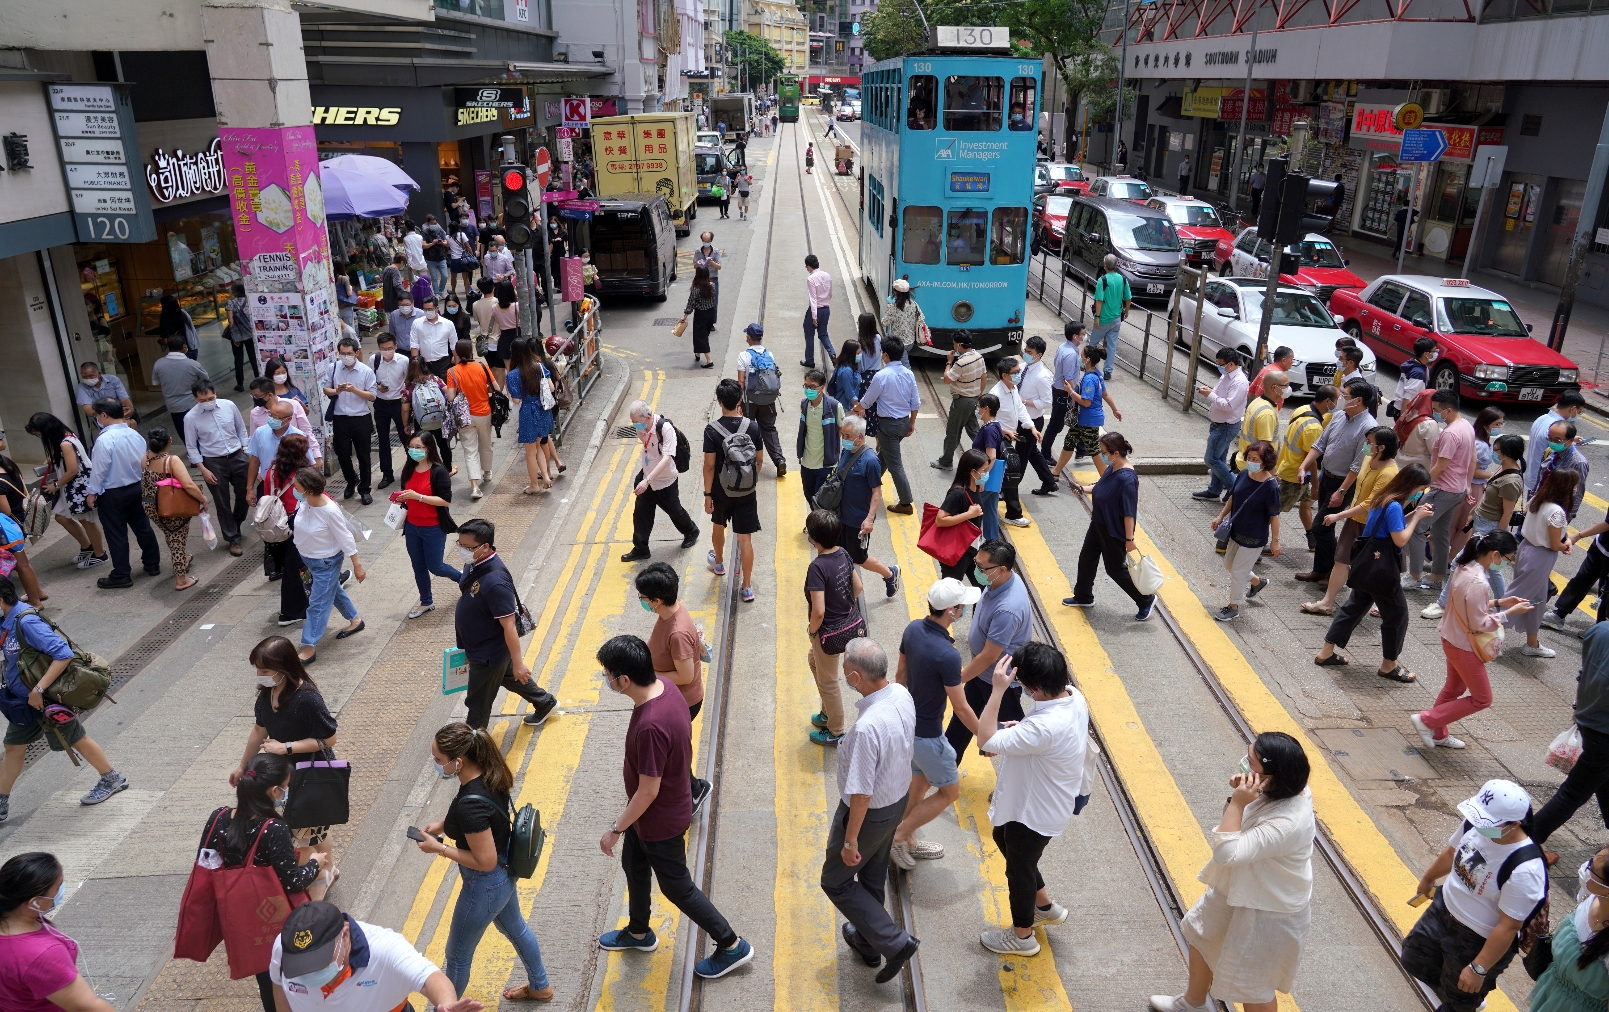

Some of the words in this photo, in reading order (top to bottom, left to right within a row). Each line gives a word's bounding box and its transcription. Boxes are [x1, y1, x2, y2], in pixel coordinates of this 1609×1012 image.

[956, 28, 993, 46] 130
[1205, 51, 1240, 66] SOUTHORN
[1245, 49, 1278, 65] SADIUM
[913, 62, 932, 73] 130
[1017, 64, 1034, 75] 130
[311, 106, 402, 126] HERS
[457, 107, 498, 126] SKECHERS
[960, 140, 1008, 150] Investment
[959, 150, 1001, 161] Managers
[87, 216, 131, 240] 120
[258, 252, 292, 263] TENNIS
[258, 264, 294, 273] TRAINING
[916, 280, 1009, 289] AXA-IM.COM.HK/TOMORROW
[1007, 331, 1023, 342] 130
